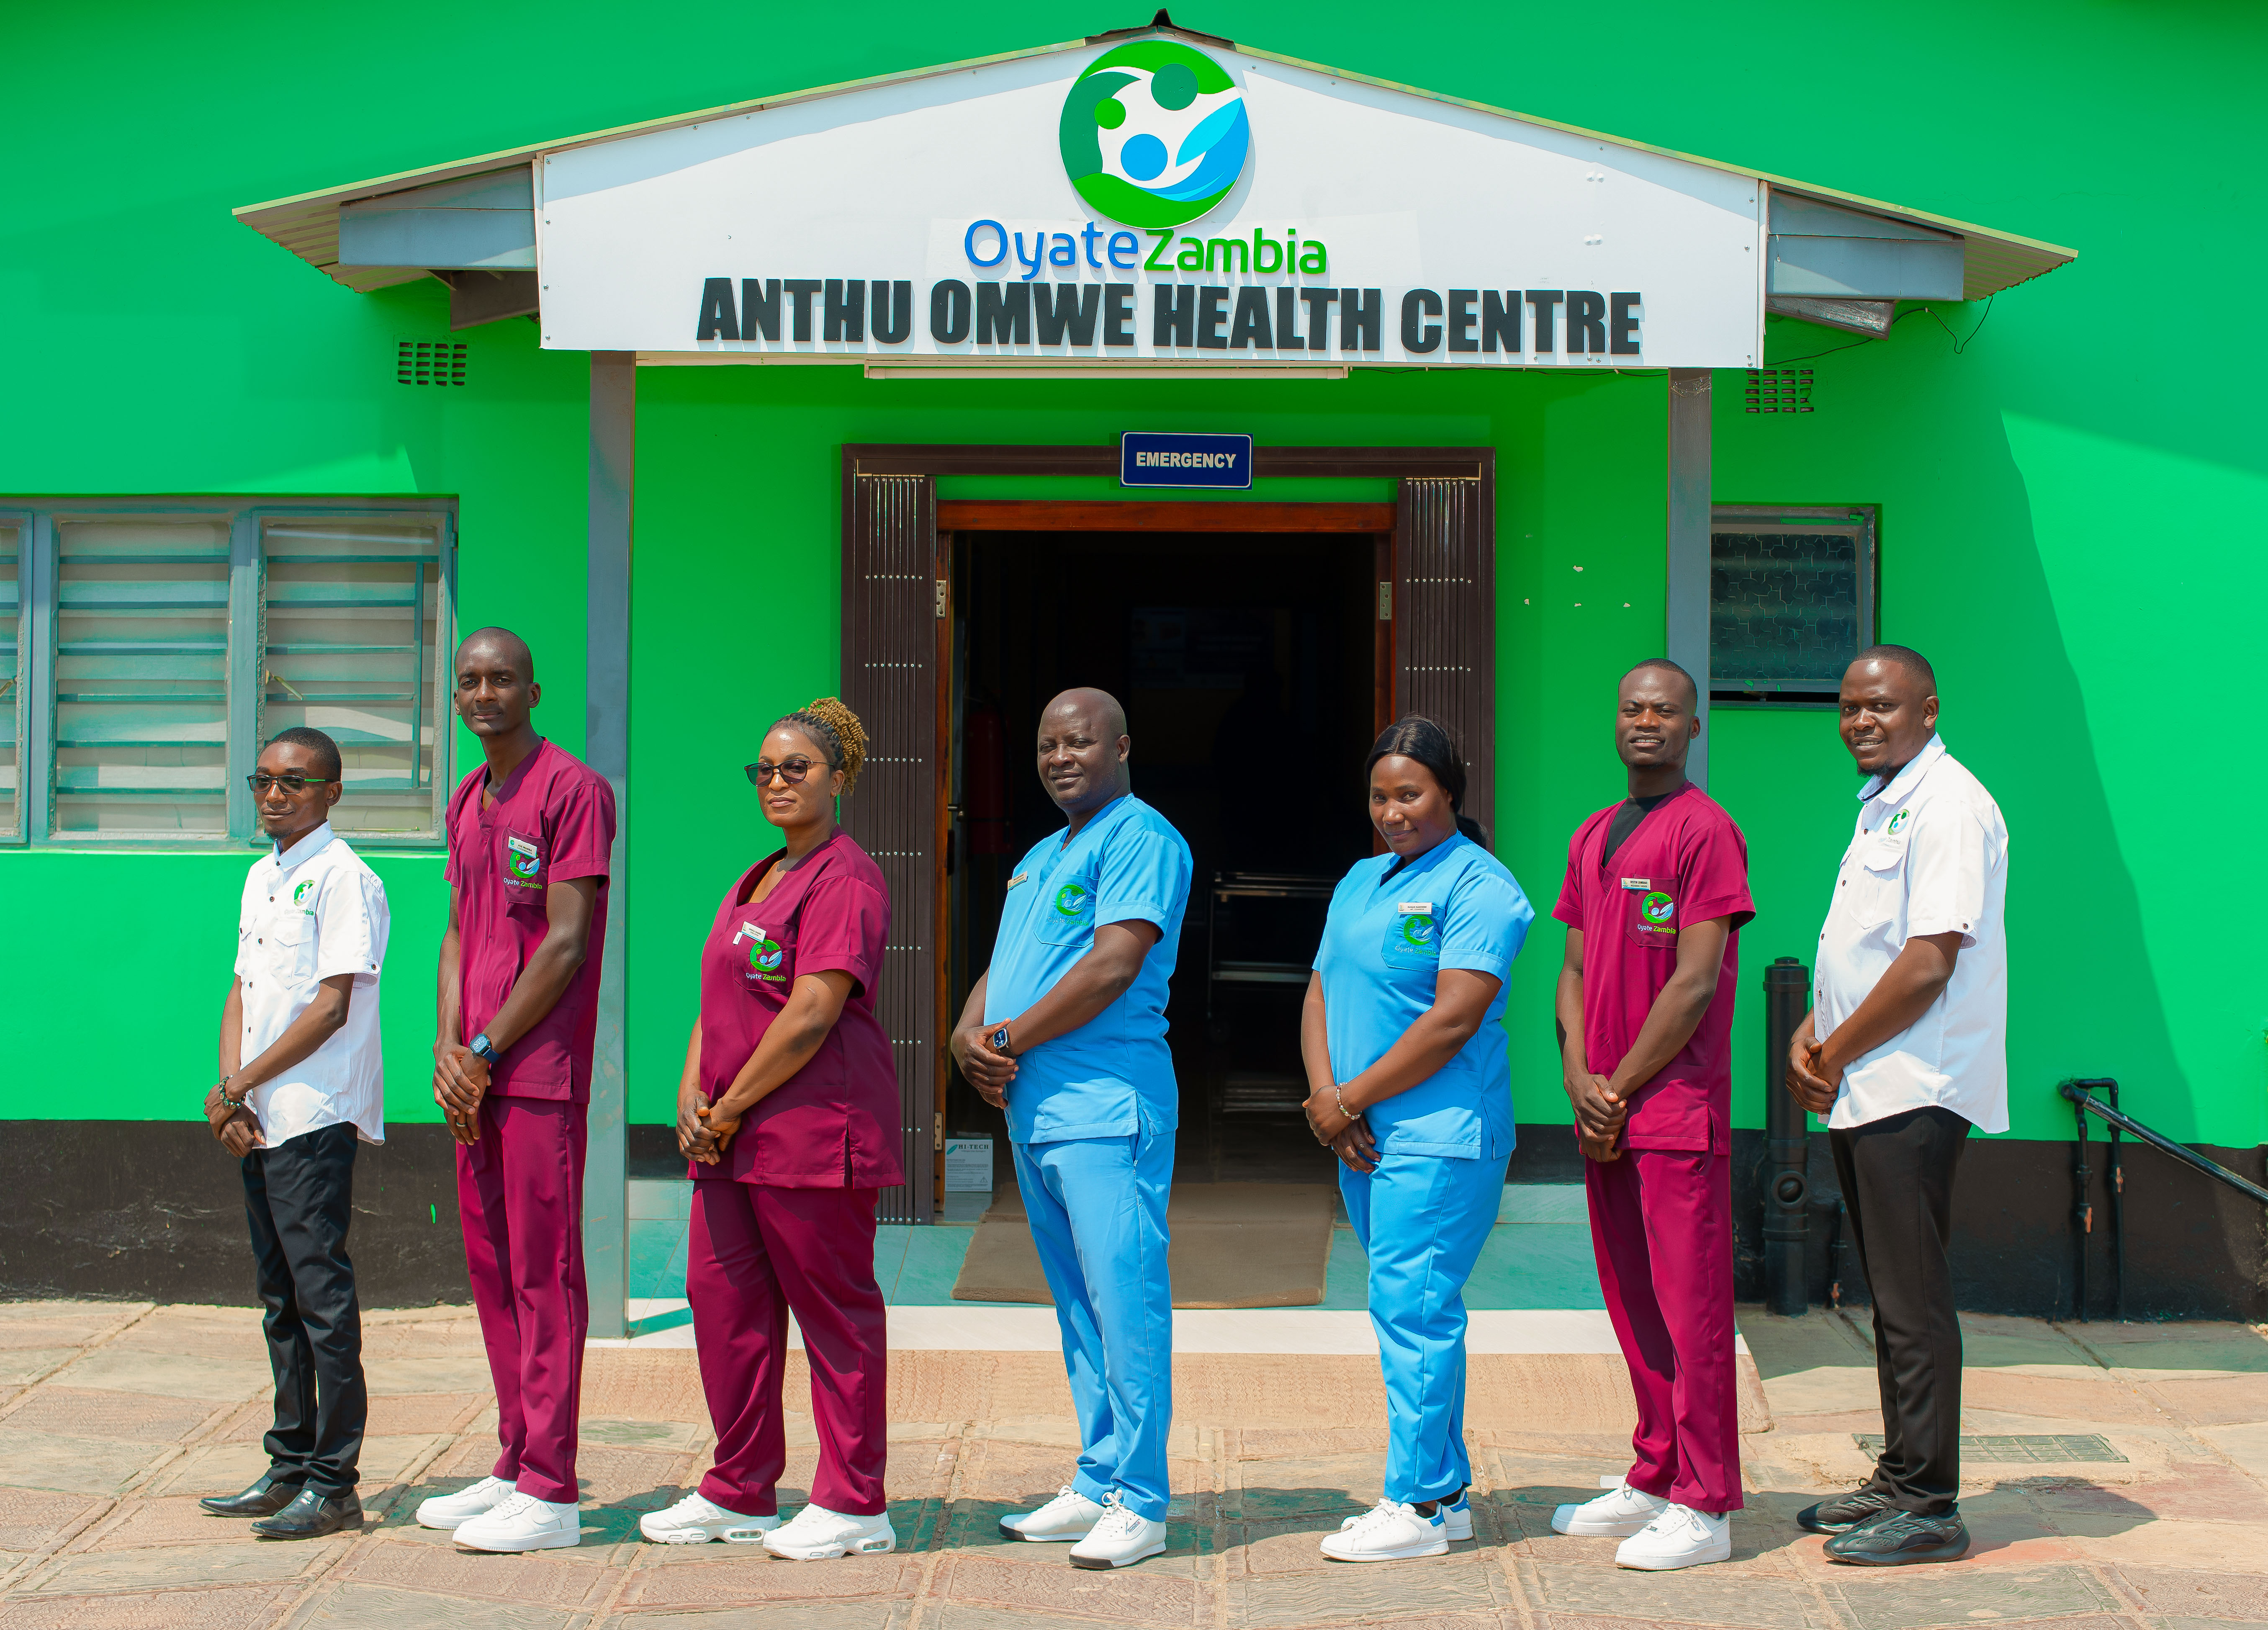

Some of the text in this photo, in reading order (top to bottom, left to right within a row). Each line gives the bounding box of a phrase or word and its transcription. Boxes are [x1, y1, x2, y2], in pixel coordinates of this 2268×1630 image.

[964, 219, 1327, 280] Oyate Zambia
[697, 278, 1641, 355] ANTHU OMWE HEALTH CENTRE
[1137, 452, 1236, 468] EMERGENCY
[503, 878, 542, 889] Oyate Zambia
[1066, 918, 1089, 927] Zambia
[1653, 926, 1676, 934] Zambia
[1414, 948, 1437, 956] Zambia
